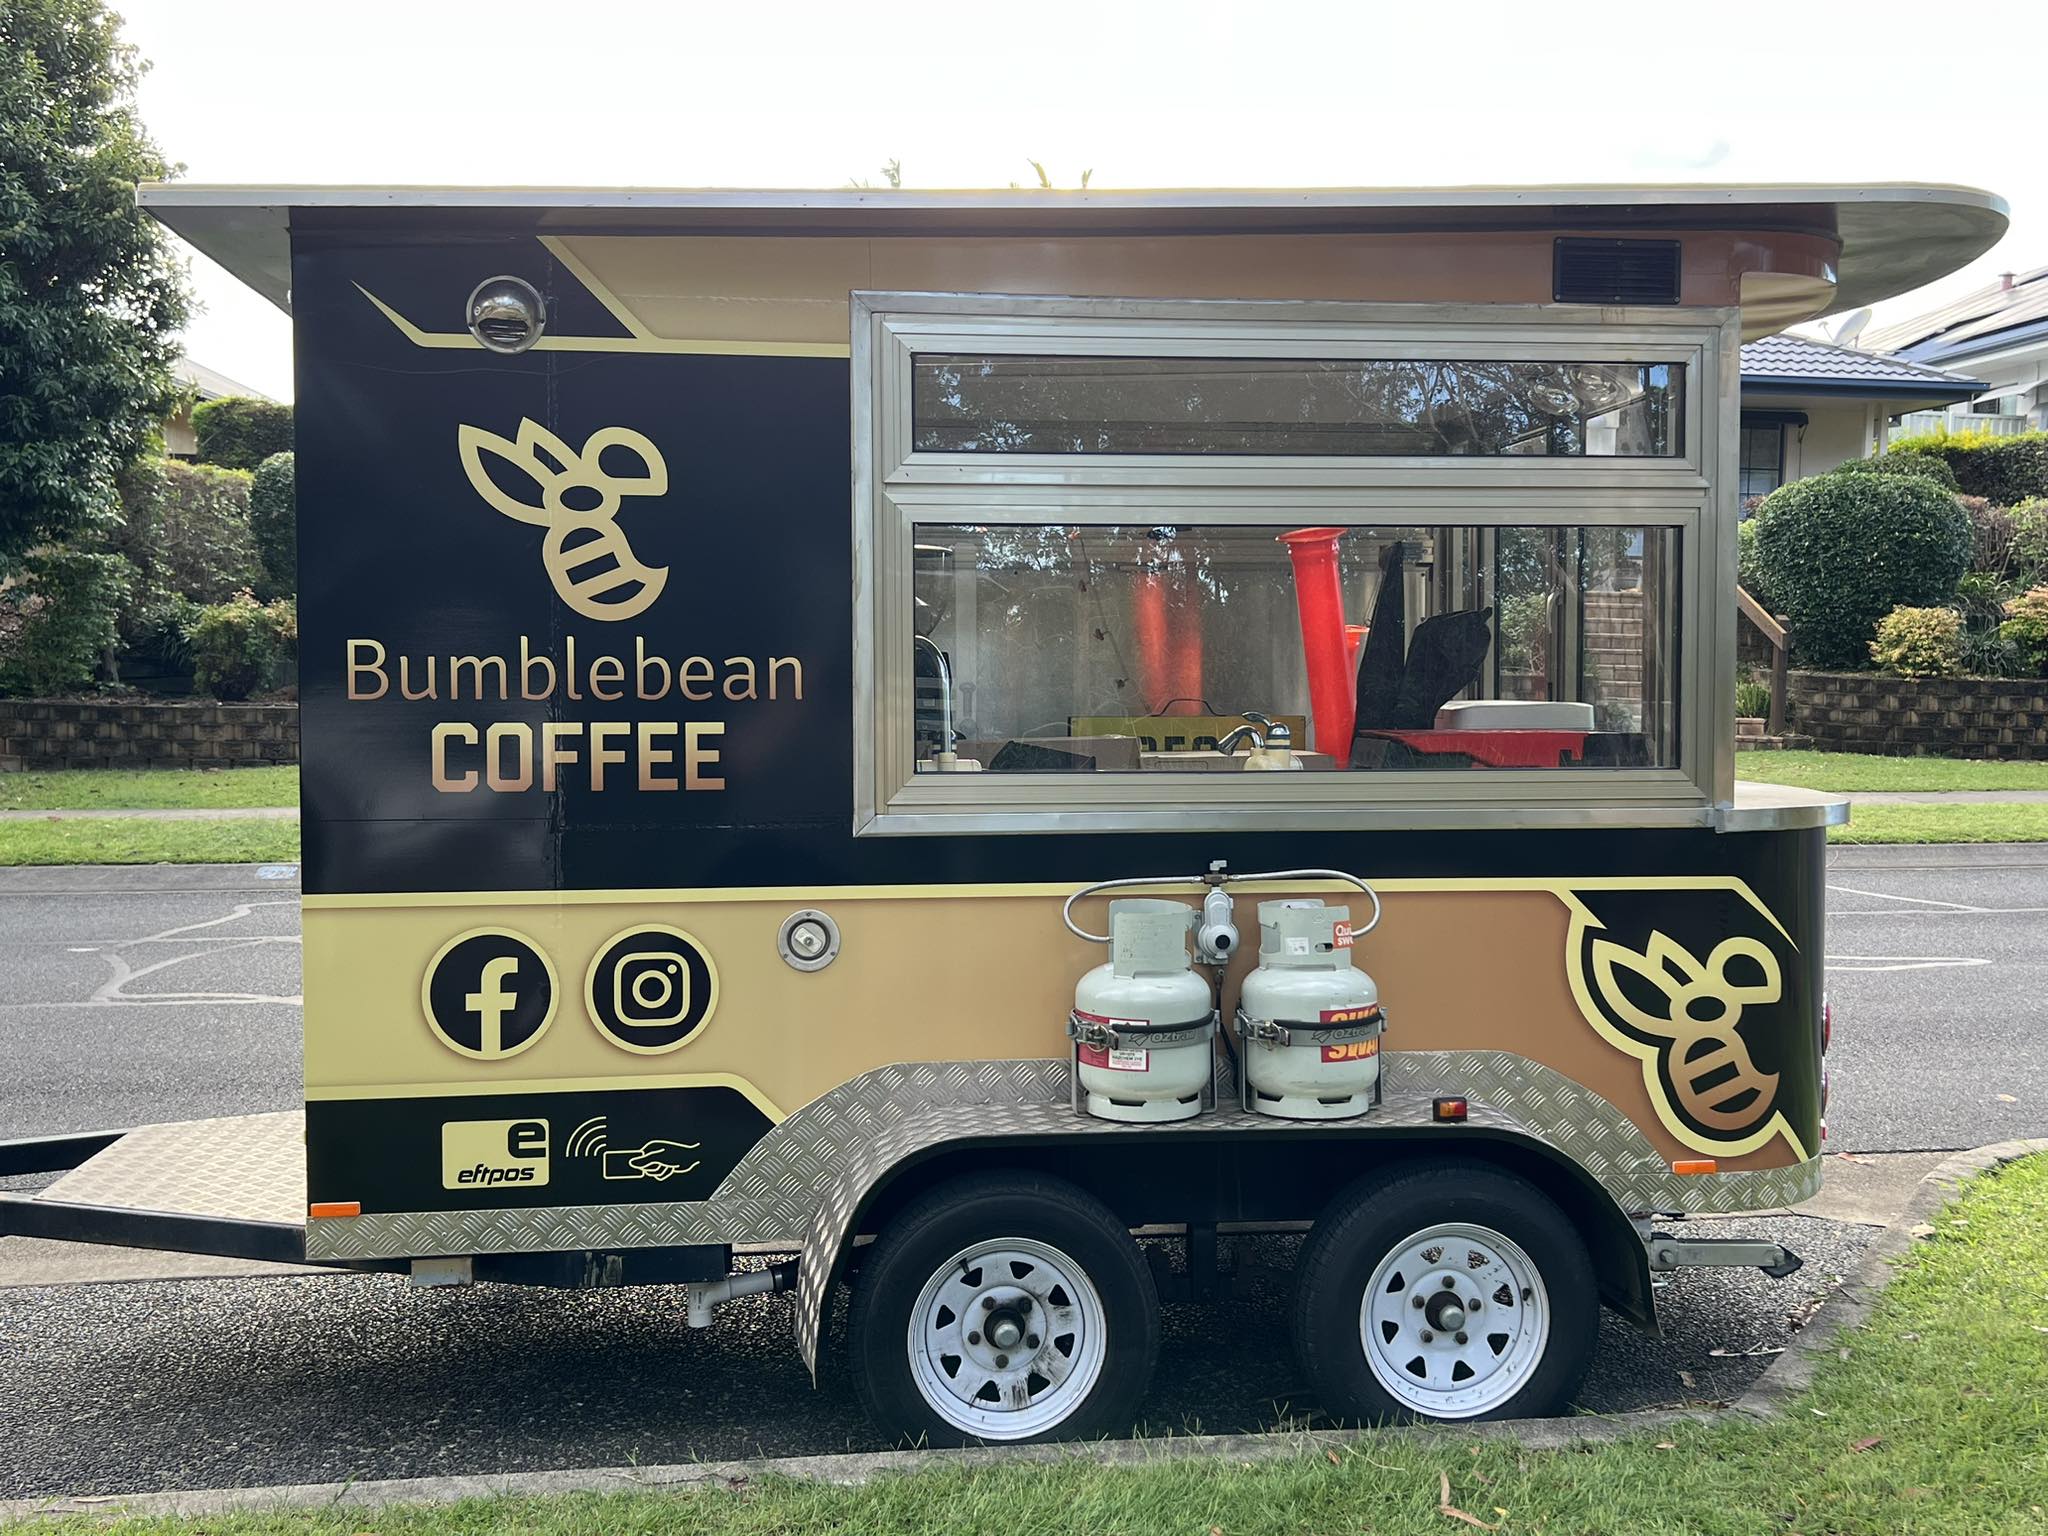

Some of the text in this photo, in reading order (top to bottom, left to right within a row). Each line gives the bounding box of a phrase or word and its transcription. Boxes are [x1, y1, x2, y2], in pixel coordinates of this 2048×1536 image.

[346, 635, 804, 701] Bumblebean
[431, 721, 726, 793] COFFEE
[457, 1163, 535, 1186] eftpos
